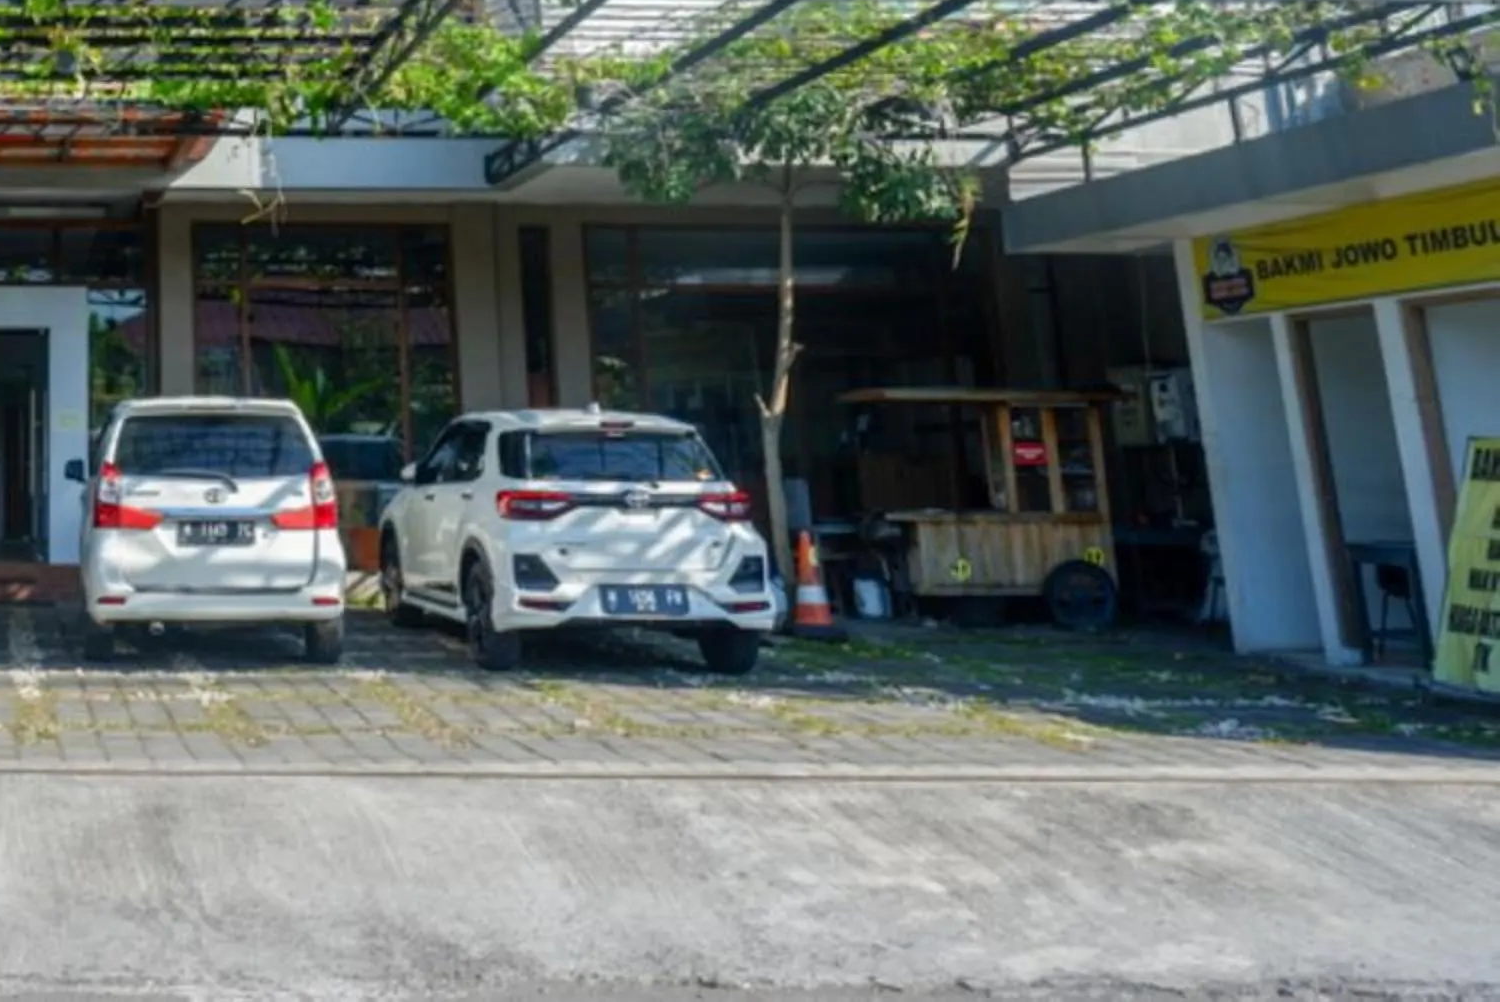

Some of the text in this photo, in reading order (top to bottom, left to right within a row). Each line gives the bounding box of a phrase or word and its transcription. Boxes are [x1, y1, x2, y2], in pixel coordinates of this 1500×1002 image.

[1256, 220, 1500, 281] BAKMI JOWO TIMBUL
